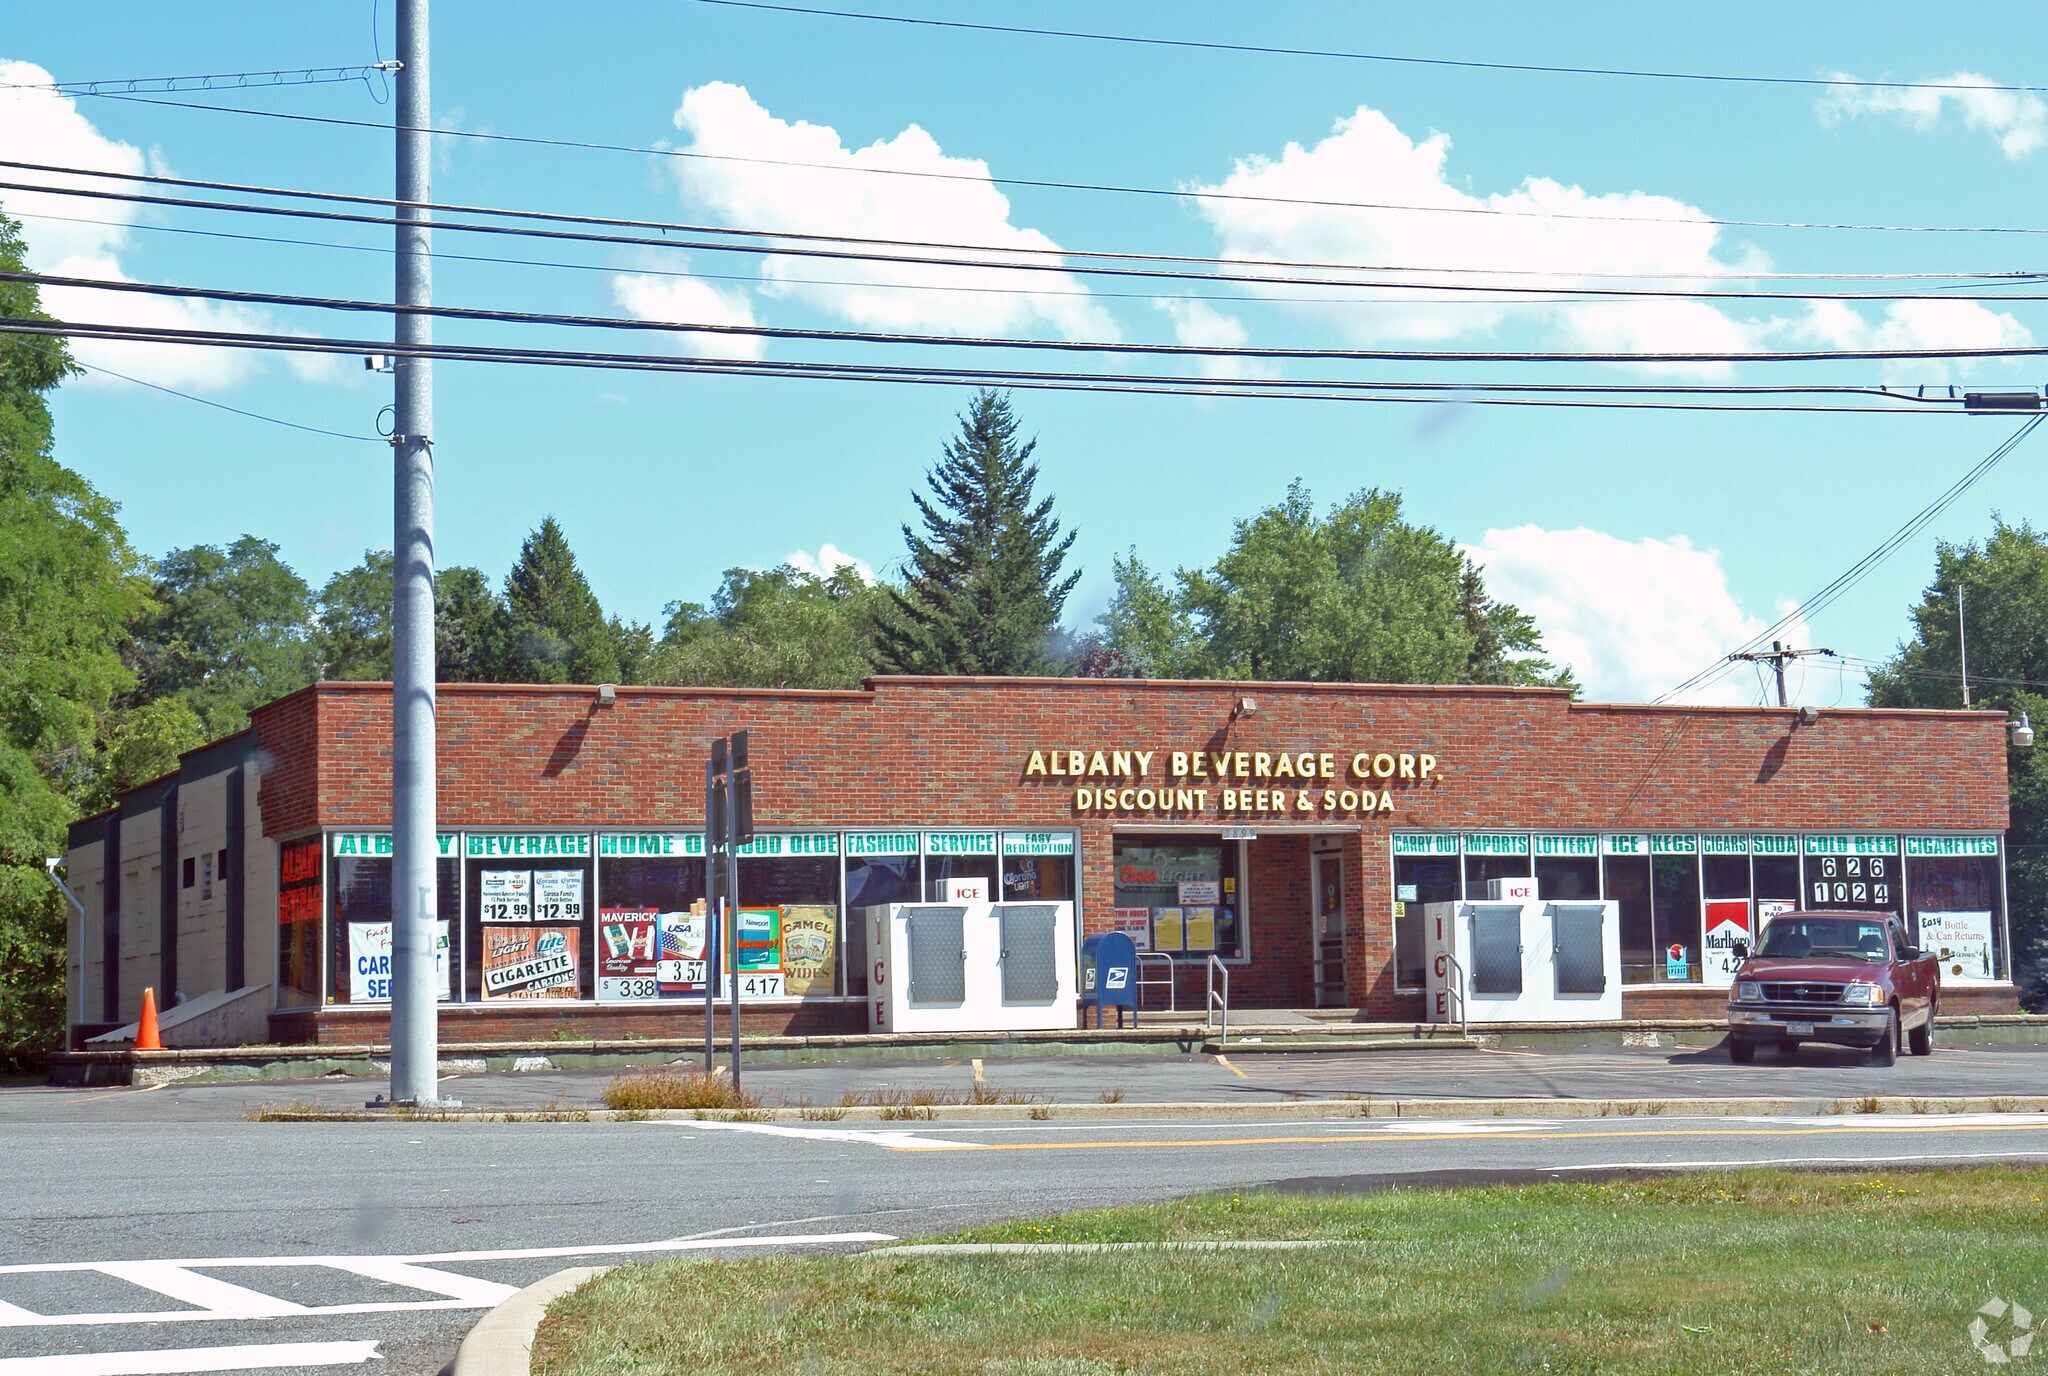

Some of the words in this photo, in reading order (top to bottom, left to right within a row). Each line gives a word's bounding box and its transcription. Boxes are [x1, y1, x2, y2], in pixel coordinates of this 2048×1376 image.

[1026, 750, 1154, 776] ALBANY
[1172, 751, 1335, 778] BEVERAGE
[1352, 753, 1443, 780] CORP.
[1077, 789, 1207, 811] DISCOUNT
[1223, 790, 1286, 811] BEER
[1297, 789, 1314, 811] &
[1324, 790, 1395, 811] SODA
[339, 834, 453, 854] ALBY
[469, 834, 589, 855] BEVERAGE
[601, 835, 674, 854] HOME
[685, 834, 707, 854] O
[790, 835, 837, 854] OLDE
[847, 834, 917, 853] FASHION
[930, 834, 994, 853] SERVICE
[1025, 833, 1052, 844] EASY
[1394, 835, 1432, 853] CARRY
[1436, 835, 1458, 853] OUT
[1465, 835, 1527, 853] IMPORTS
[1535, 836, 1596, 854] LOTTERY
[1611, 835, 1639, 853] ICE
[1651, 834, 1695, 852] KEGS
[1704, 835, 1747, 853] CIGARS
[1753, 835, 1797, 853] SODA
[1806, 836, 1848, 853] COLD
[1855, 835, 1896, 854] BEER
[1907, 836, 1996, 854] CIGARETTES
[1005, 843, 1073, 854] REDEMPTION
[282, 843, 321, 883] ALBANY
[536, 877, 559, 886] Corona
[560, 877, 581, 885] Corona
[1004, 871, 1037, 886] Corona
[1119, 864, 1159, 884] Coors
[1160, 871, 1204, 881] LIGHT
[956, 888, 981, 899] ICE
[1510, 887, 1531, 898] ICE
[601, 912, 658, 923] MAVERICK
[1921, 916, 1942, 929] Easy
[1944, 920, 1969, 930] Bottle
[365, 925, 390, 941] Fast
[667, 924, 692, 933] USA
[684, 929, 705, 939] Gold
[782, 920, 833, 934] CAMEL
[536, 936, 566, 953] Lite
[1705, 929, 1751, 949] Marlboro
[1926, 932, 1934, 941] &
[1936, 932, 1952, 941] Can
[1954, 932, 1985, 941] Returns
[491, 941, 529, 959] LIGHT
[490, 954, 570, 985] CIGARETTE
[605, 957, 632, 965] American
[1721, 956, 1746, 974] 4.2
[673, 960, 704, 982] 3.57
[783, 967, 831, 979] WIDES
[526, 970, 576, 992] CARTONS
[603, 980, 609, 990] $
[620, 979, 656, 998] 3.38
[745, 978, 780, 996] 4.17
